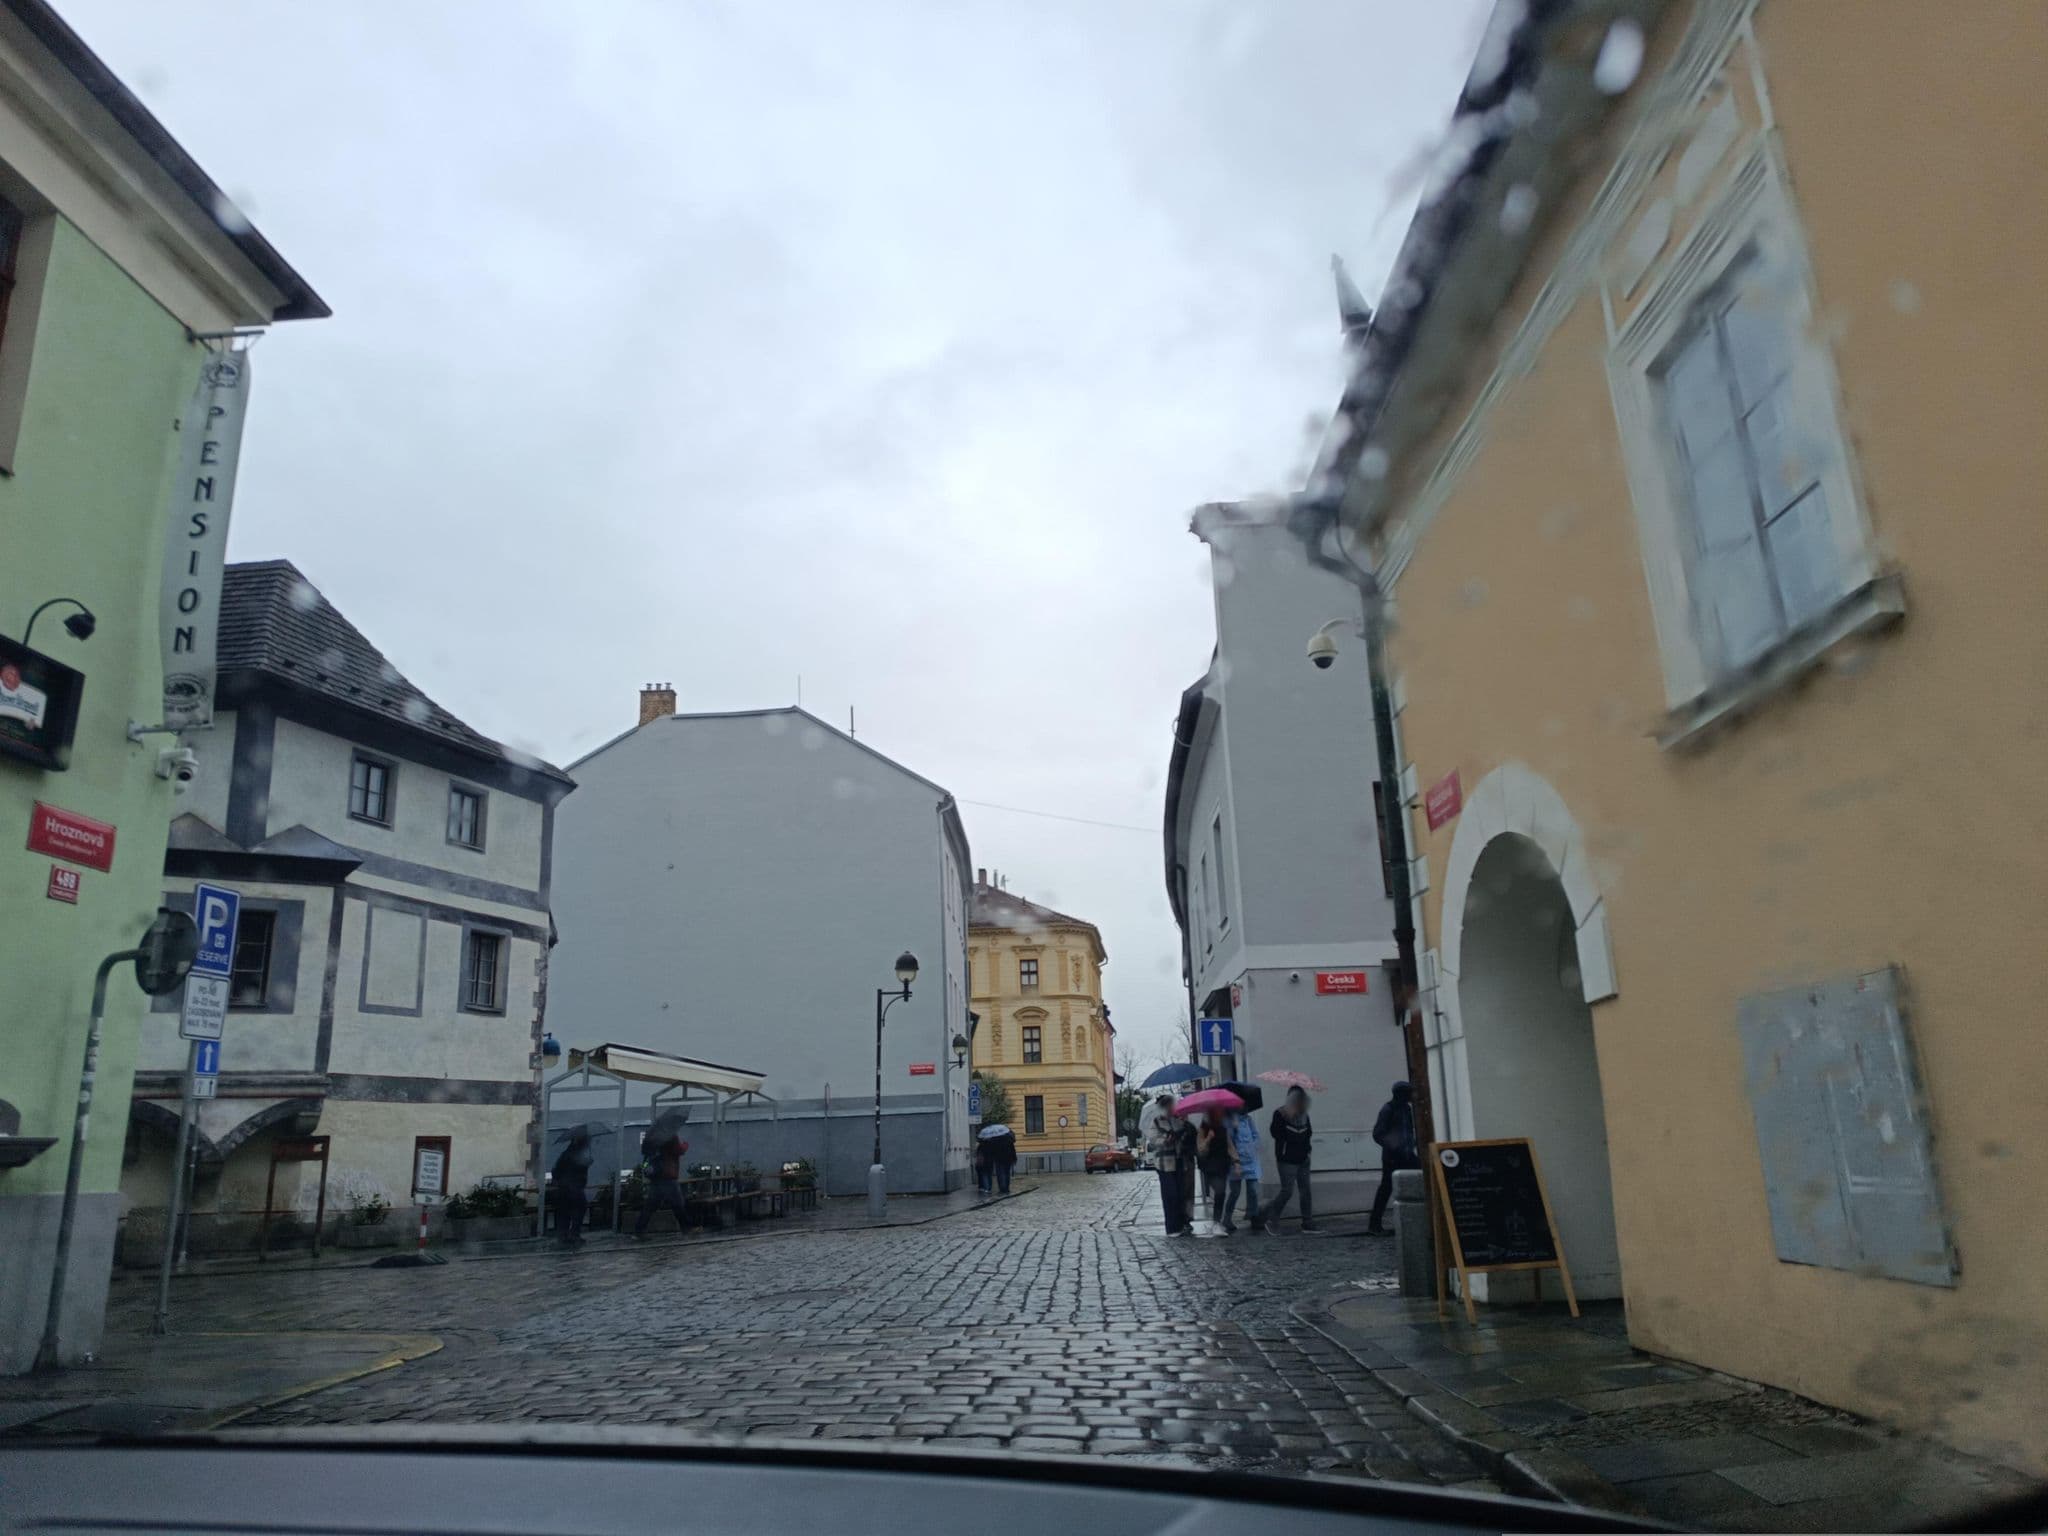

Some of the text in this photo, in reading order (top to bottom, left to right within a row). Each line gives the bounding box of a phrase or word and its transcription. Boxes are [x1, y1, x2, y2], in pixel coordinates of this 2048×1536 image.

[173, 405, 225, 653] PENSION
[45, 815, 105, 849] Hroznová
[202, 895, 229, 945] P
[1327, 974, 1356, 985] Česká
